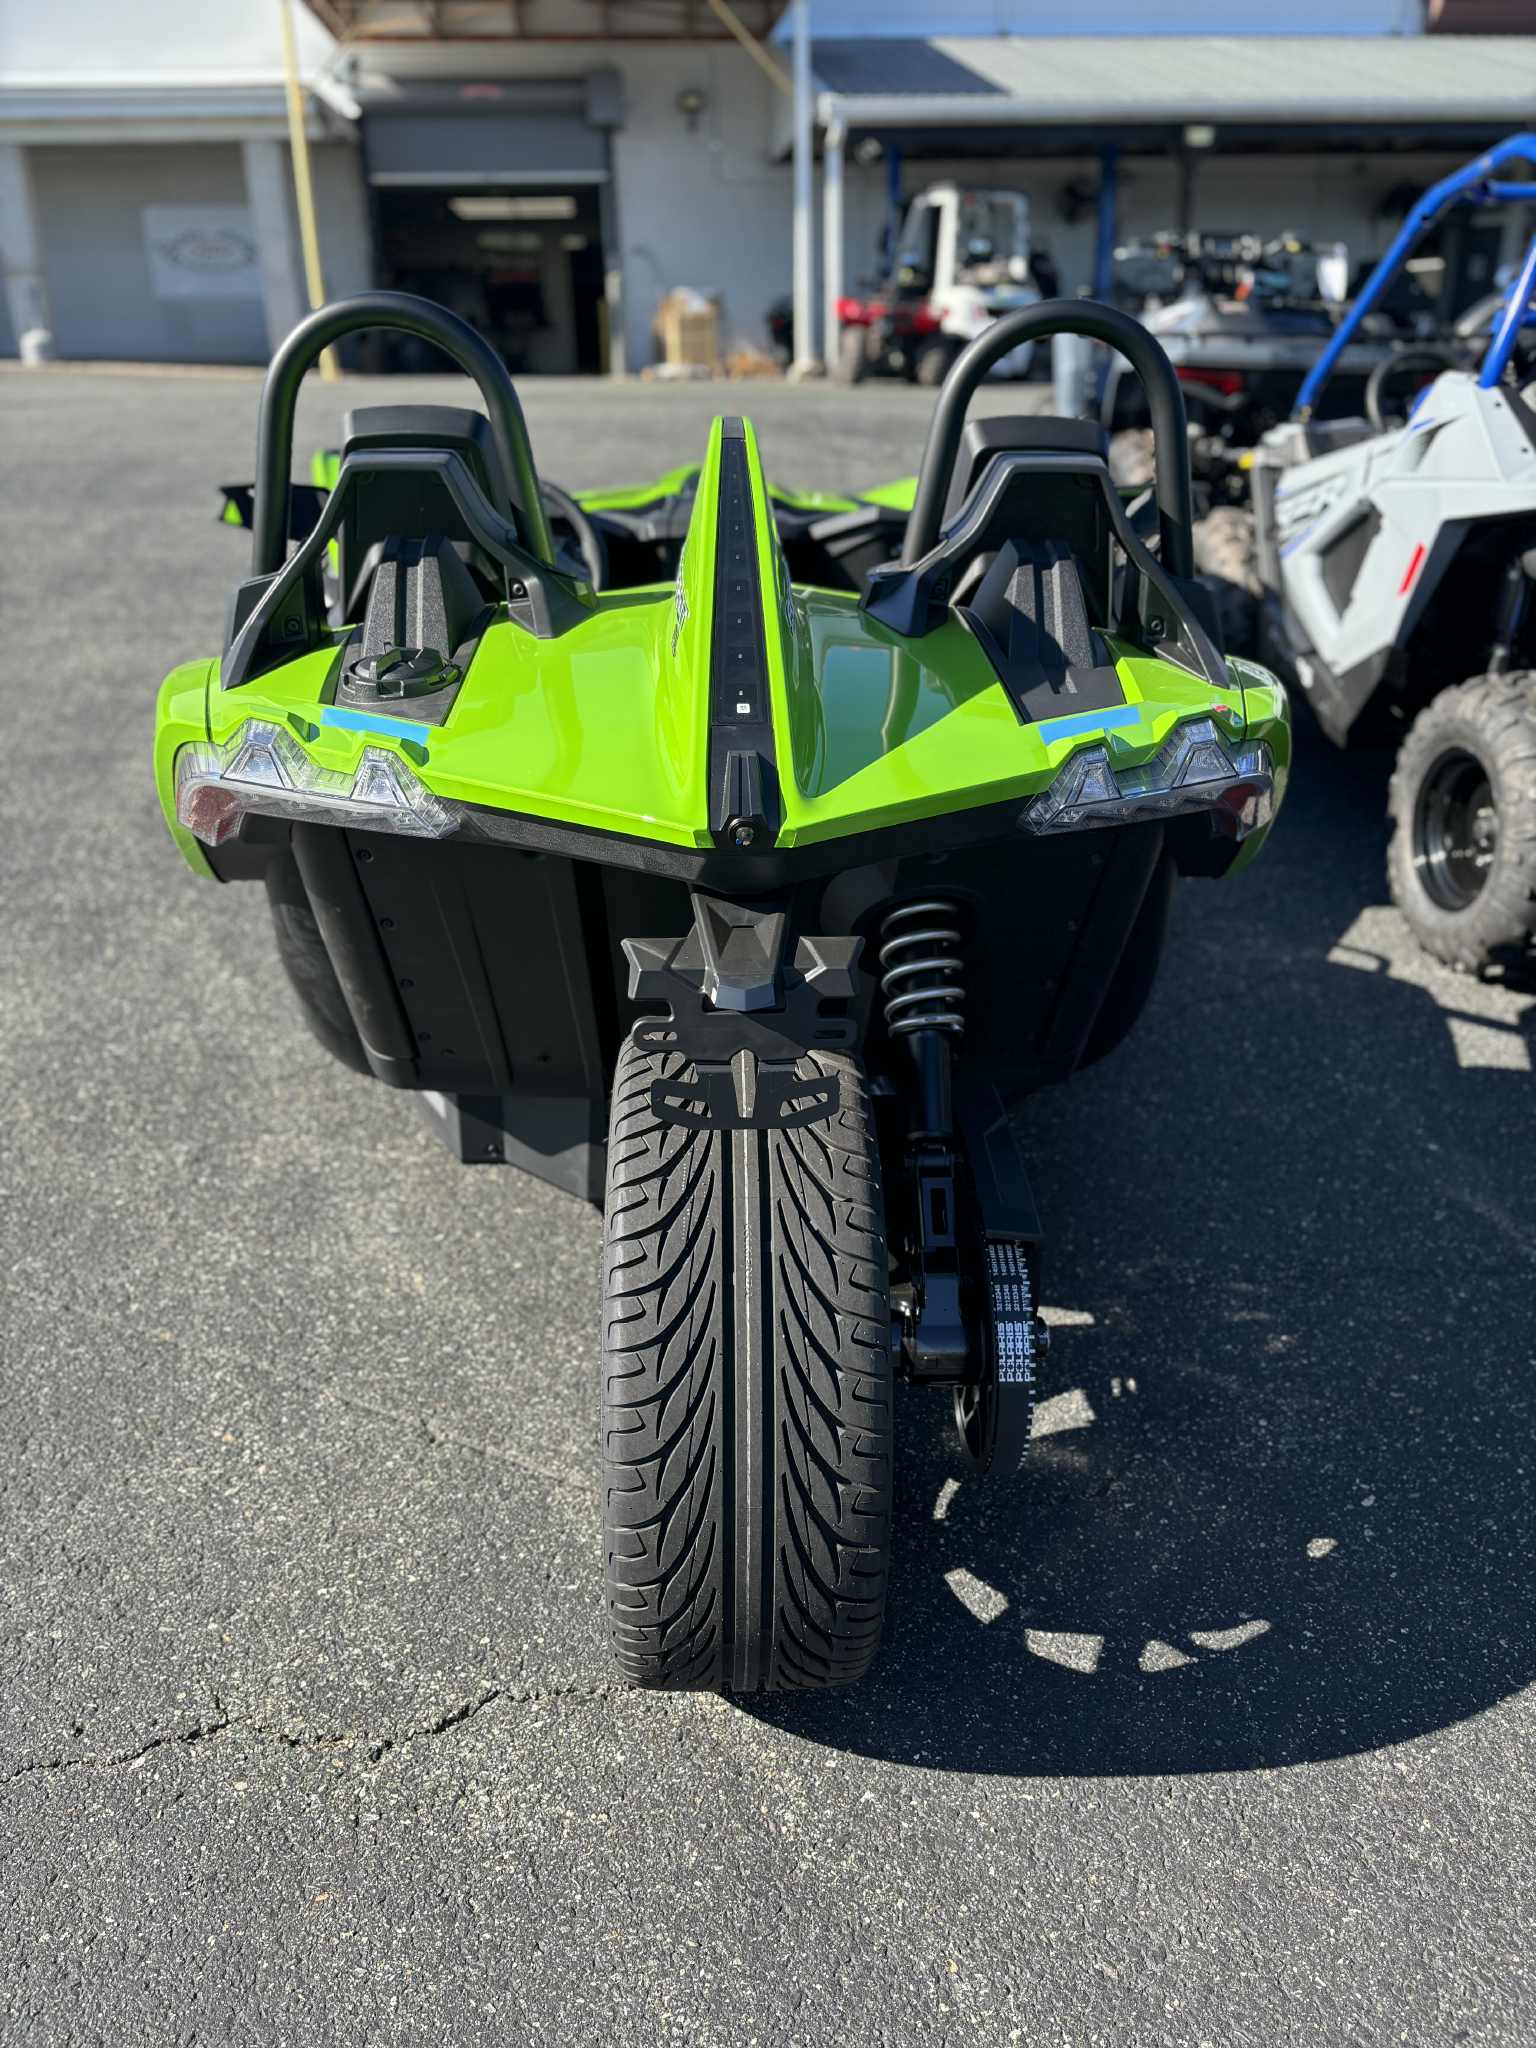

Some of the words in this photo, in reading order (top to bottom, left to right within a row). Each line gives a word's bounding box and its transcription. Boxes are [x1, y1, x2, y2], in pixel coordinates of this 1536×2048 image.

[998, 1322, 1006, 1382] POLARIS
[1006, 1321, 1014, 1382] POLARIS
[1014, 1321, 1023, 1382] POLARIS
